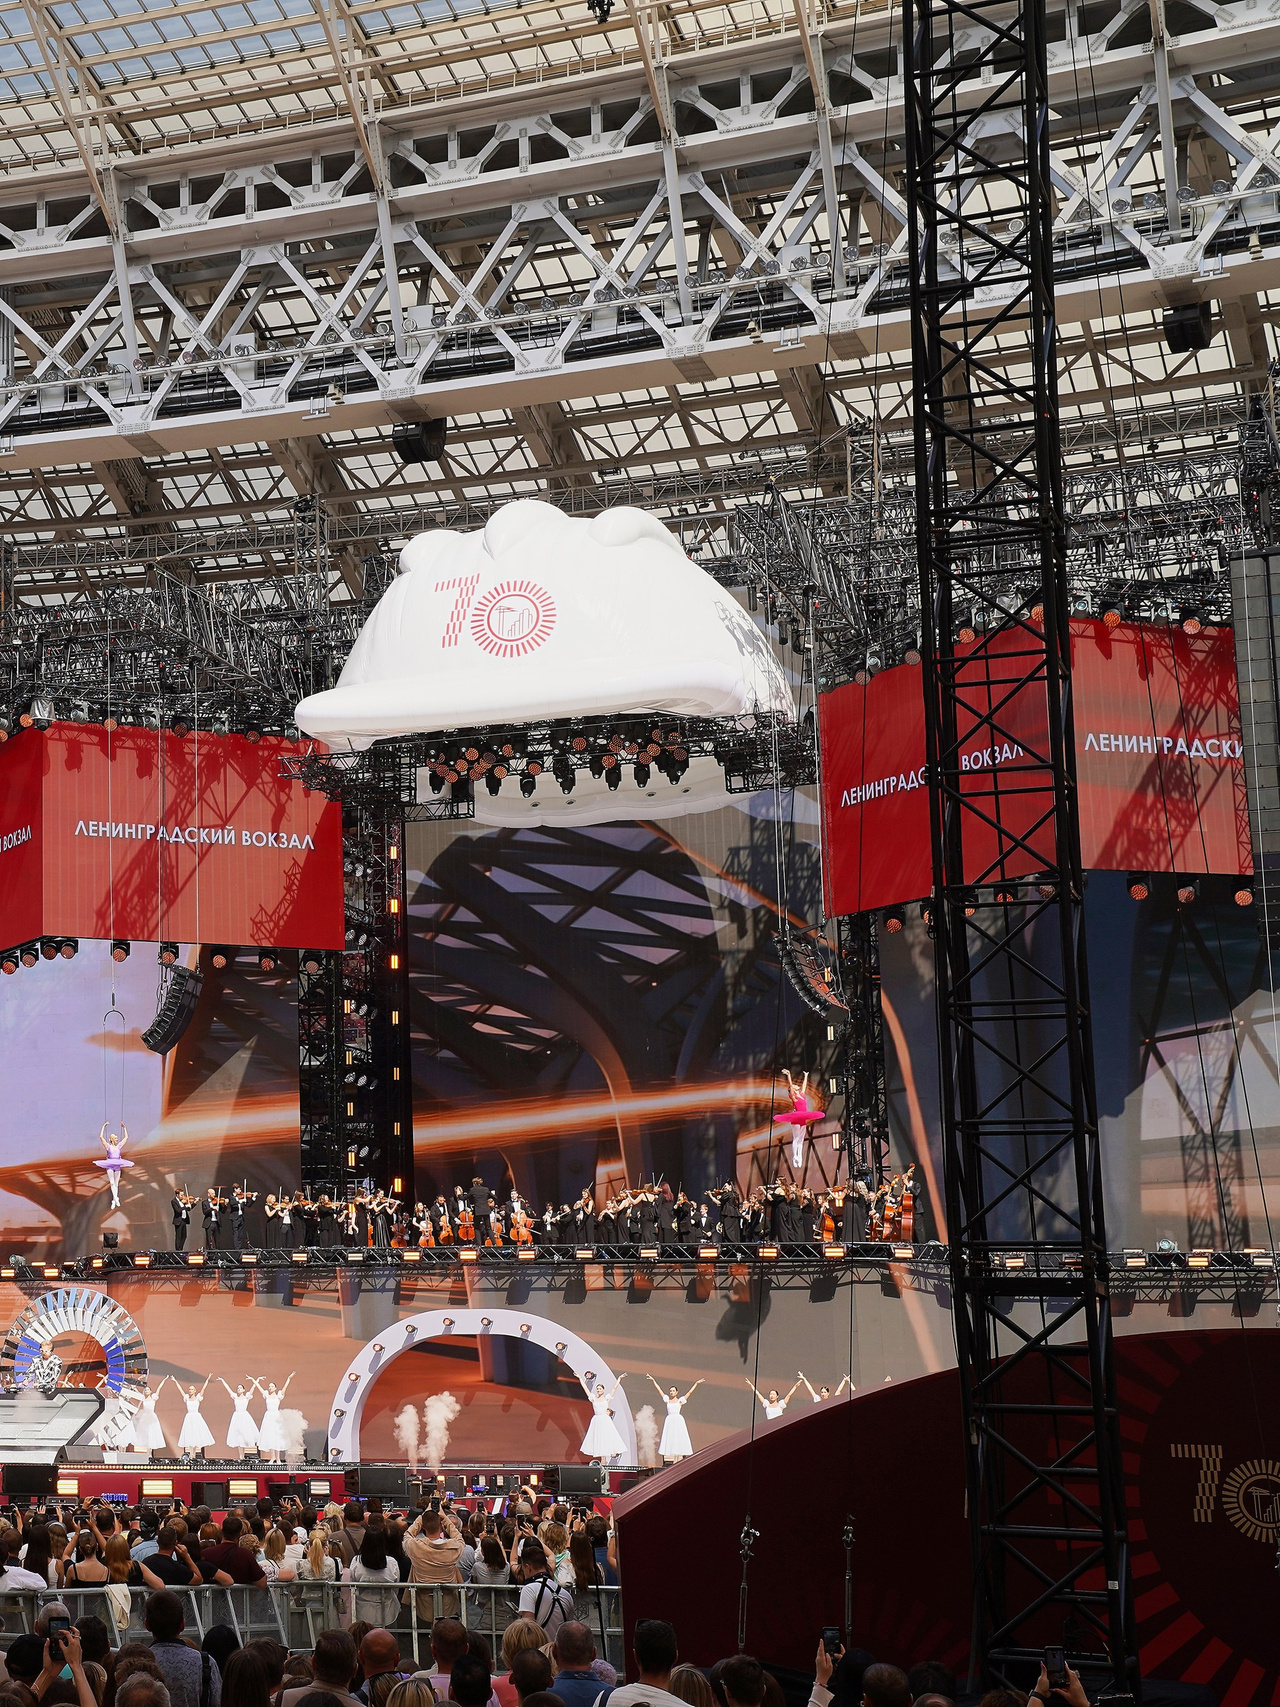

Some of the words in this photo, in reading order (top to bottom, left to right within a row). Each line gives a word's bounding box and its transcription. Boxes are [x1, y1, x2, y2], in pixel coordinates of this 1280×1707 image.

[961, 743, 1024, 771] ВОКЗАЛ
[2, 824, 32, 852] ВОКЗАЛ
[74, 820, 236, 845] ЛЕНИНГРАДСКИЙ
[241, 830, 315, 850] ВОКЗАЛ
